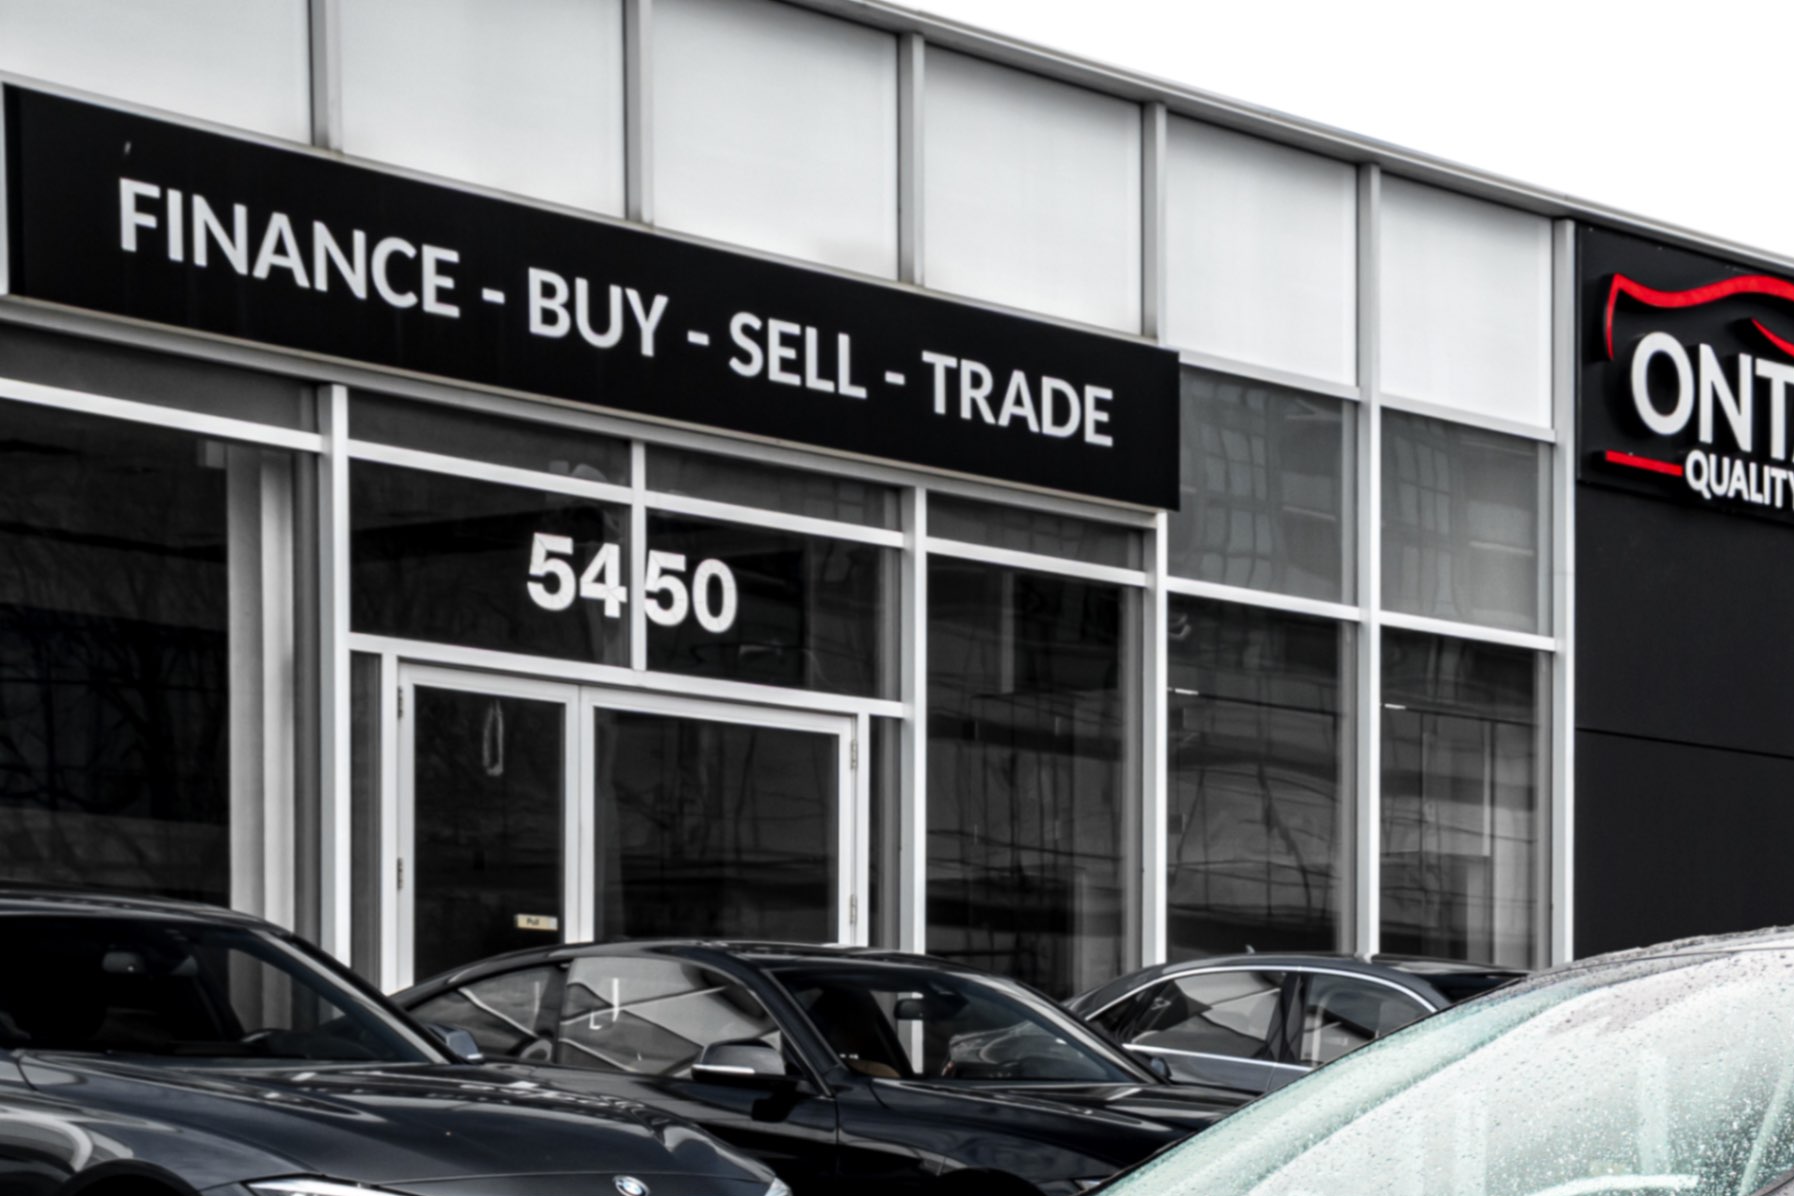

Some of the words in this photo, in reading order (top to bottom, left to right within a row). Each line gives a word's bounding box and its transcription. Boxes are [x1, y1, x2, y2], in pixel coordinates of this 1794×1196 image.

[119, 176, 461, 319] FINANCE
[528, 266, 669, 358] BUY
[728, 311, 868, 400] SELL
[921, 349, 1114, 448] TRADE
[526, 531, 738, 634] 5450
